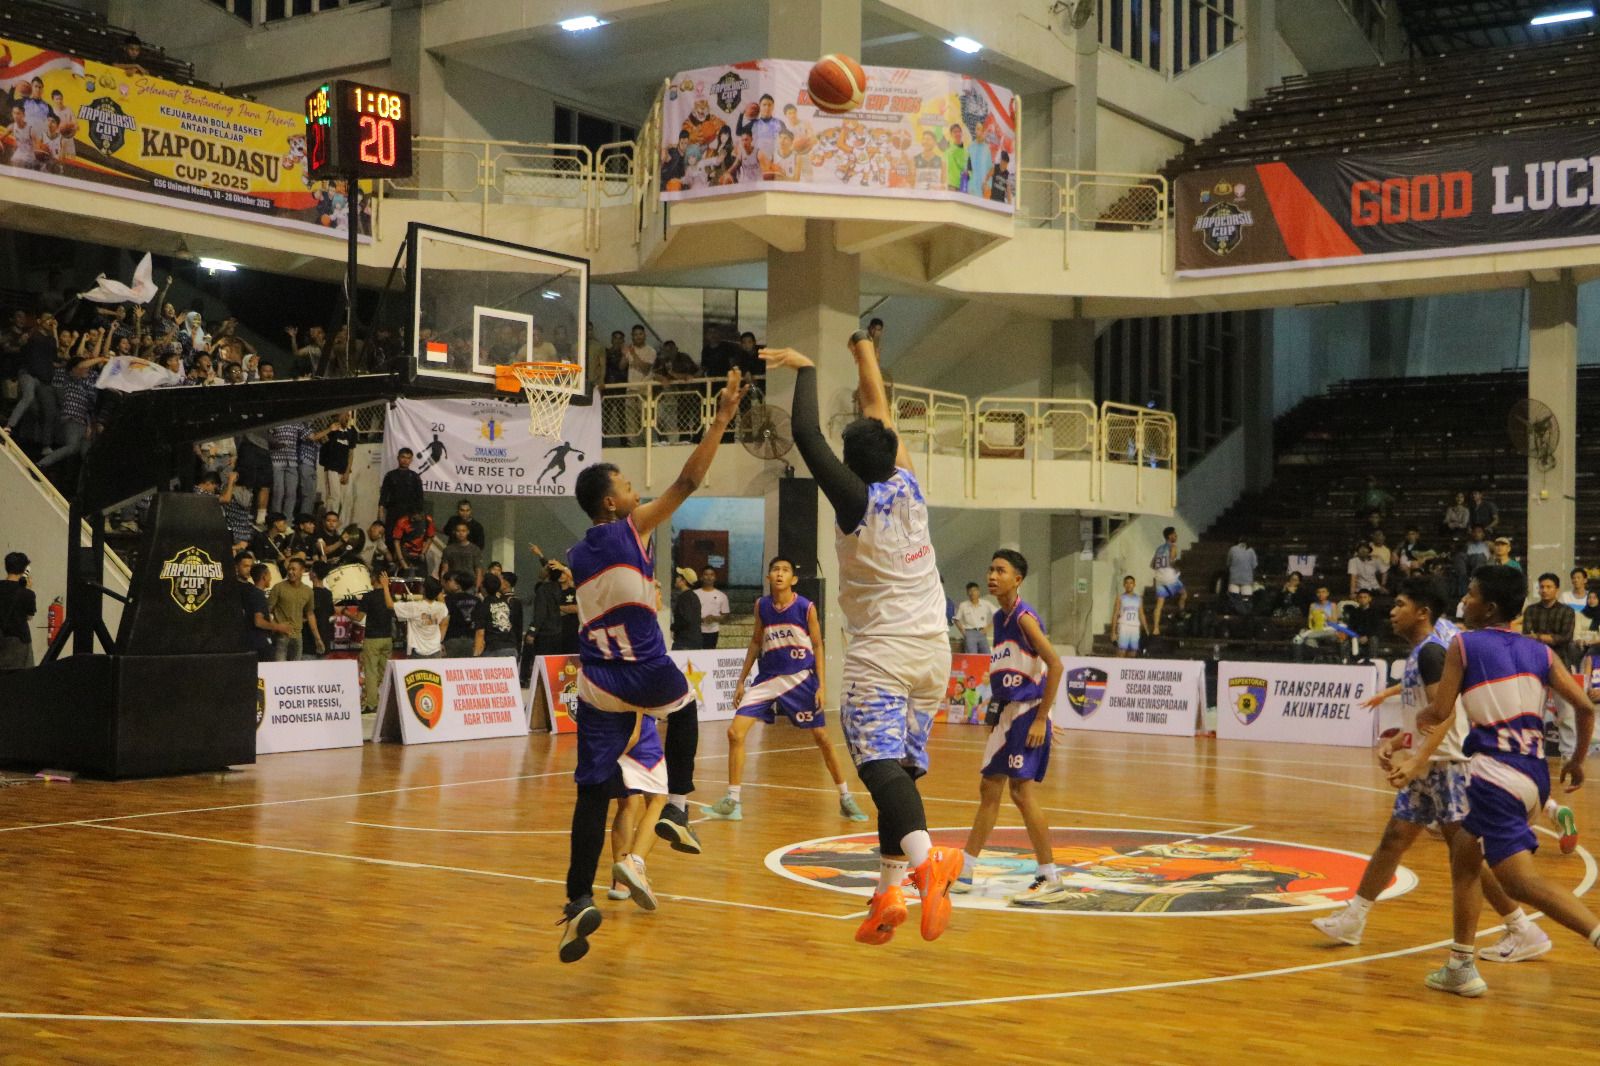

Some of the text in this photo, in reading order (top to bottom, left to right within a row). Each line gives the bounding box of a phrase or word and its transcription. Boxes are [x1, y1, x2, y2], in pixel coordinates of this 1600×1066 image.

[136, 78, 180, 97] Selamat
[354, 88, 401, 121] 1:08
[160, 106, 263, 137] KEJUARAAN BOLA BASKET
[96, 122, 119, 137] CUP
[181, 122, 244, 142] ANTAR PELAJAR
[360, 115, 396, 167] 20
[141, 127, 280, 183] KAPOLDASU
[175, 164, 248, 190] CUP 2025
[154, 178, 168, 189] GSG
[168, 181, 190, 194] Unimed
[192, 186, 212, 199] Medan,
[214, 190, 220, 199] 18
[233, 194, 256, 206] Oktober
[256, 198, 270, 208] 2025
[1352, 170, 1473, 227] GOOD
[1212, 226, 1236, 237] CUP
[432, 422, 446, 433] 20
[456, 466, 525, 478] WE RISE TO
[454, 482, 482, 493] AND
[486, 484, 513, 494] YOU
[518, 484, 566, 495] BEHIND
[180, 578, 205, 588] CUP
[790, 648, 807, 660] 03
[445, 667, 515, 682] MATA YANG WASPADA
[1002, 674, 1024, 688] 08
[1120, 669, 1183, 682] DETEKSI ANCAMAN
[274, 684, 344, 696] LOGISTIK KUAT,
[456, 682, 510, 696] UNTUK MENJAGA
[1125, 684, 1174, 696] SECARA SIBER,
[1274, 680, 1364, 700] TRANSPARAN &
[280, 698, 342, 710] POLRI PRESISI,
[453, 696, 516, 711] KEAMANAN NEGARA
[1109, 696, 1188, 711] DENGAN KEWASPADAAN
[1282, 701, 1351, 720] AKUNTABEL
[272, 712, 351, 724] INDONESIA MAJU
[464, 711, 512, 726] AGAR TENTRAM
[796, 711, 814, 722] 03
[1126, 711, 1168, 724] YANG TINGGI
[1008, 754, 1025, 769] 08
